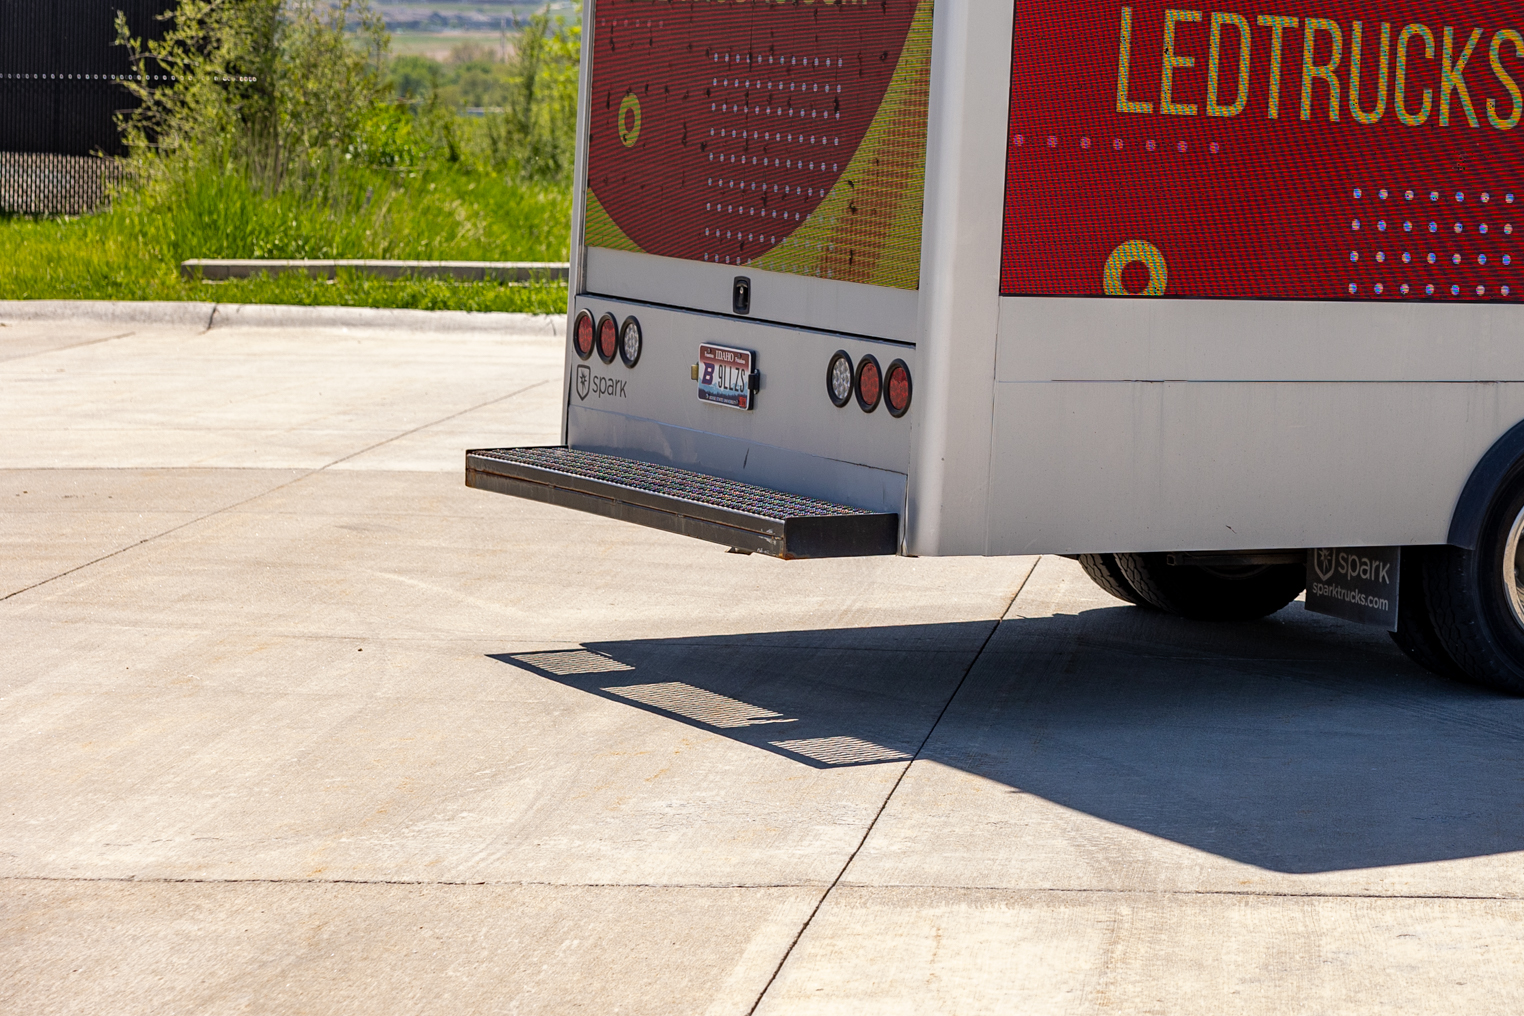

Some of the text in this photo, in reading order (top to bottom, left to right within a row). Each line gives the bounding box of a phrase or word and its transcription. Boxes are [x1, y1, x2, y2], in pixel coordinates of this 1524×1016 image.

[715, 350, 734, 362] IDAHO
[592, 375, 628, 399] spark
[1337, 551, 1391, 585] spark
[1312, 581, 1390, 612] sparktrucks.com
